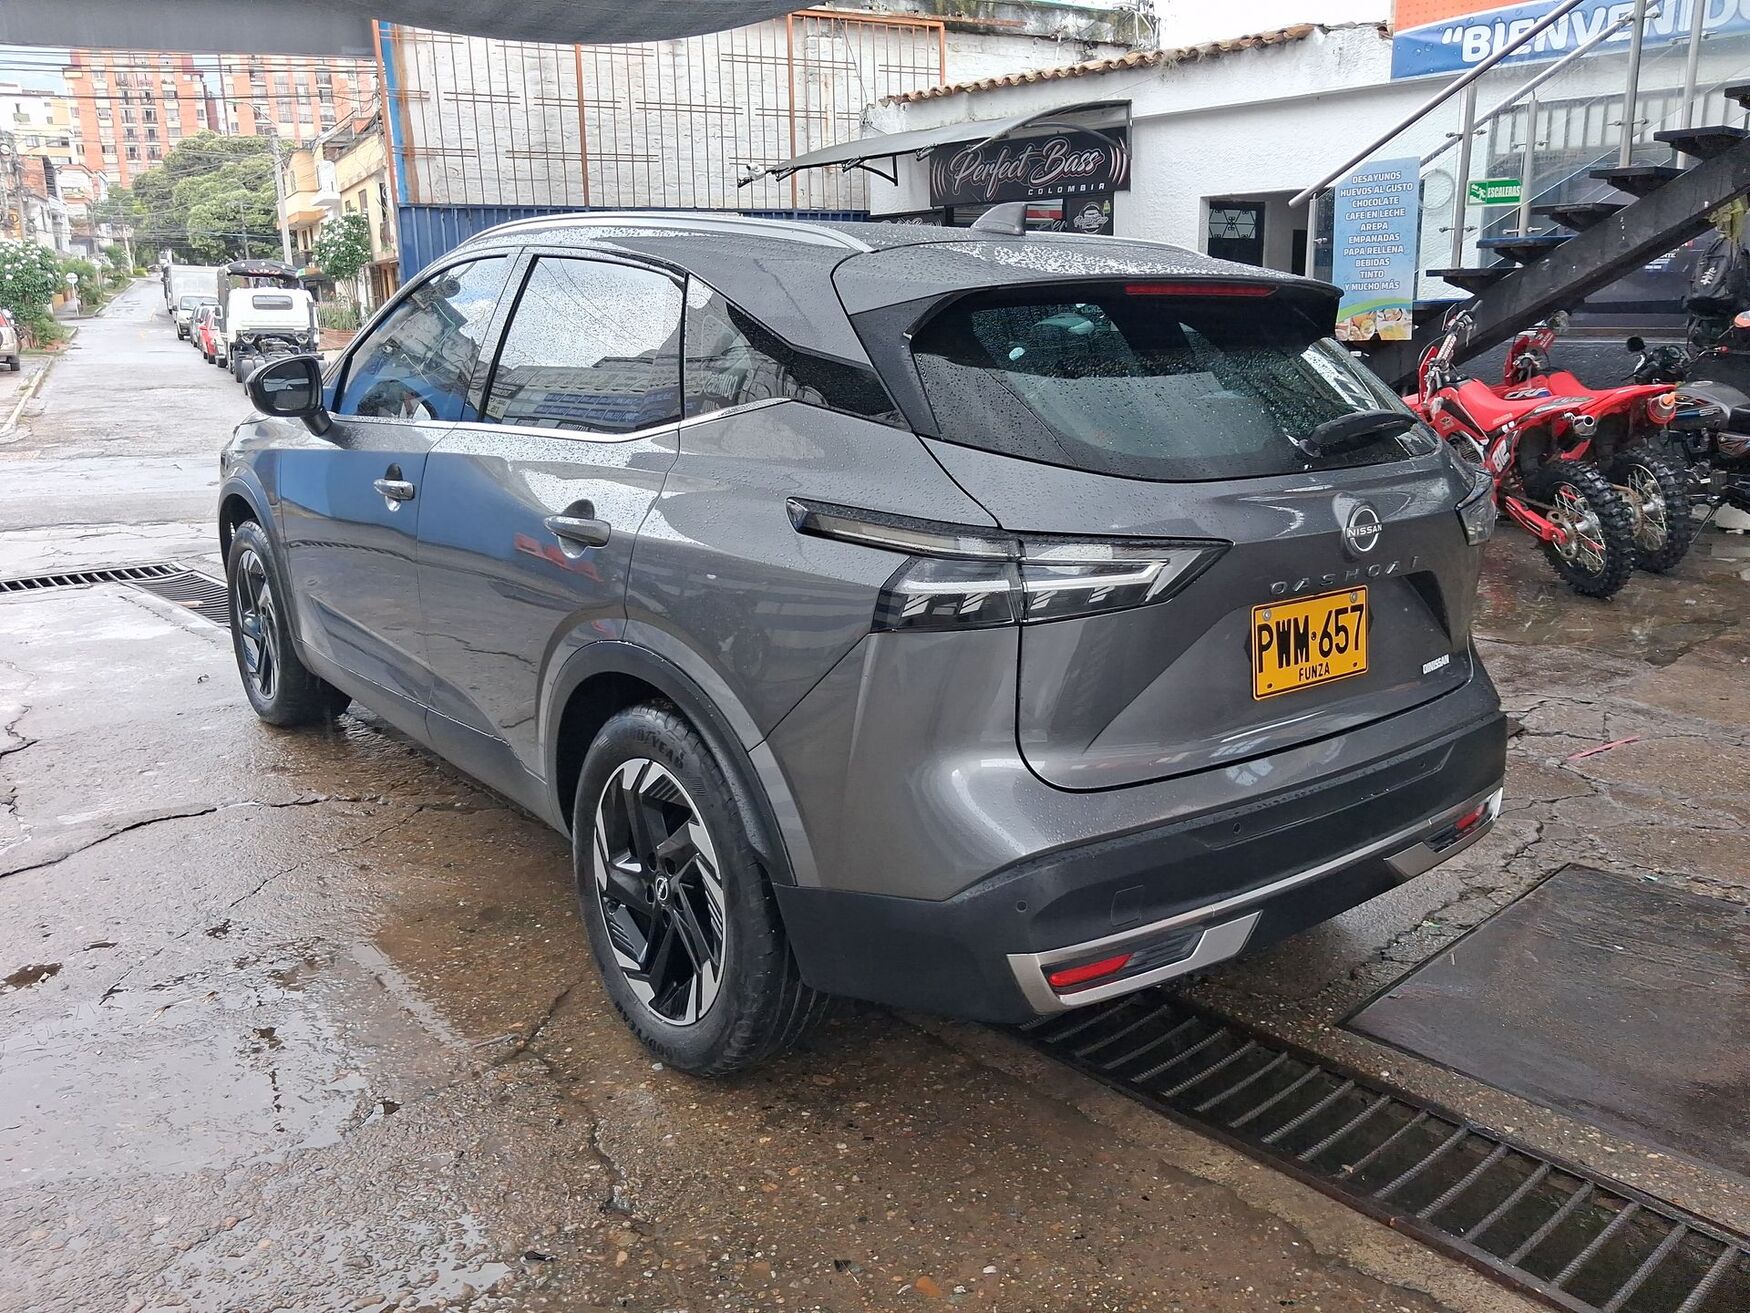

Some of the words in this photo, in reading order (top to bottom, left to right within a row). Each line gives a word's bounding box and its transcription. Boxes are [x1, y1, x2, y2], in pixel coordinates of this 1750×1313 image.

[1441, 0, 1750, 63] “BIENVENID
[950, 144, 1034, 198] Perfect
[1030, 139, 1101, 184] Bass
[1352, 171, 1401, 184] DESAYUNOS
[1028, 183, 1105, 196] COLOMBIA
[1340, 187, 1373, 197] HUEVOS
[1374, 185, 1384, 194] AL
[1386, 182, 1413, 193] GUSTO
[1487, 186, 1520, 198] ESCALERAS
[1352, 196, 1399, 208] CHOCOLATE
[1345, 211, 1365, 220] CAFE
[1366, 210, 1378, 219] EN
[1379, 208, 1406, 218] LECHE
[1360, 222, 1388, 231] AREPA
[1348, 233, 1400, 244] EMPANADAS
[1343, 247, 1365, 256] PAPA
[1366, 245, 1404, 255] RELLENA
[1355, 258, 1390, 267] BEBIDAS
[1360, 270, 1384, 279] TINTO
[1344, 283, 1350, 291] Y
[1351, 282, 1379, 291] MUCHO
[1381, 278, 1400, 290] MÁS
[1346, 522, 1383, 541] NISSAN
[1257, 614, 1310, 674] PWM
[1318, 603, 1365, 659] 657
[1298, 662, 1330, 682] FUNZA
